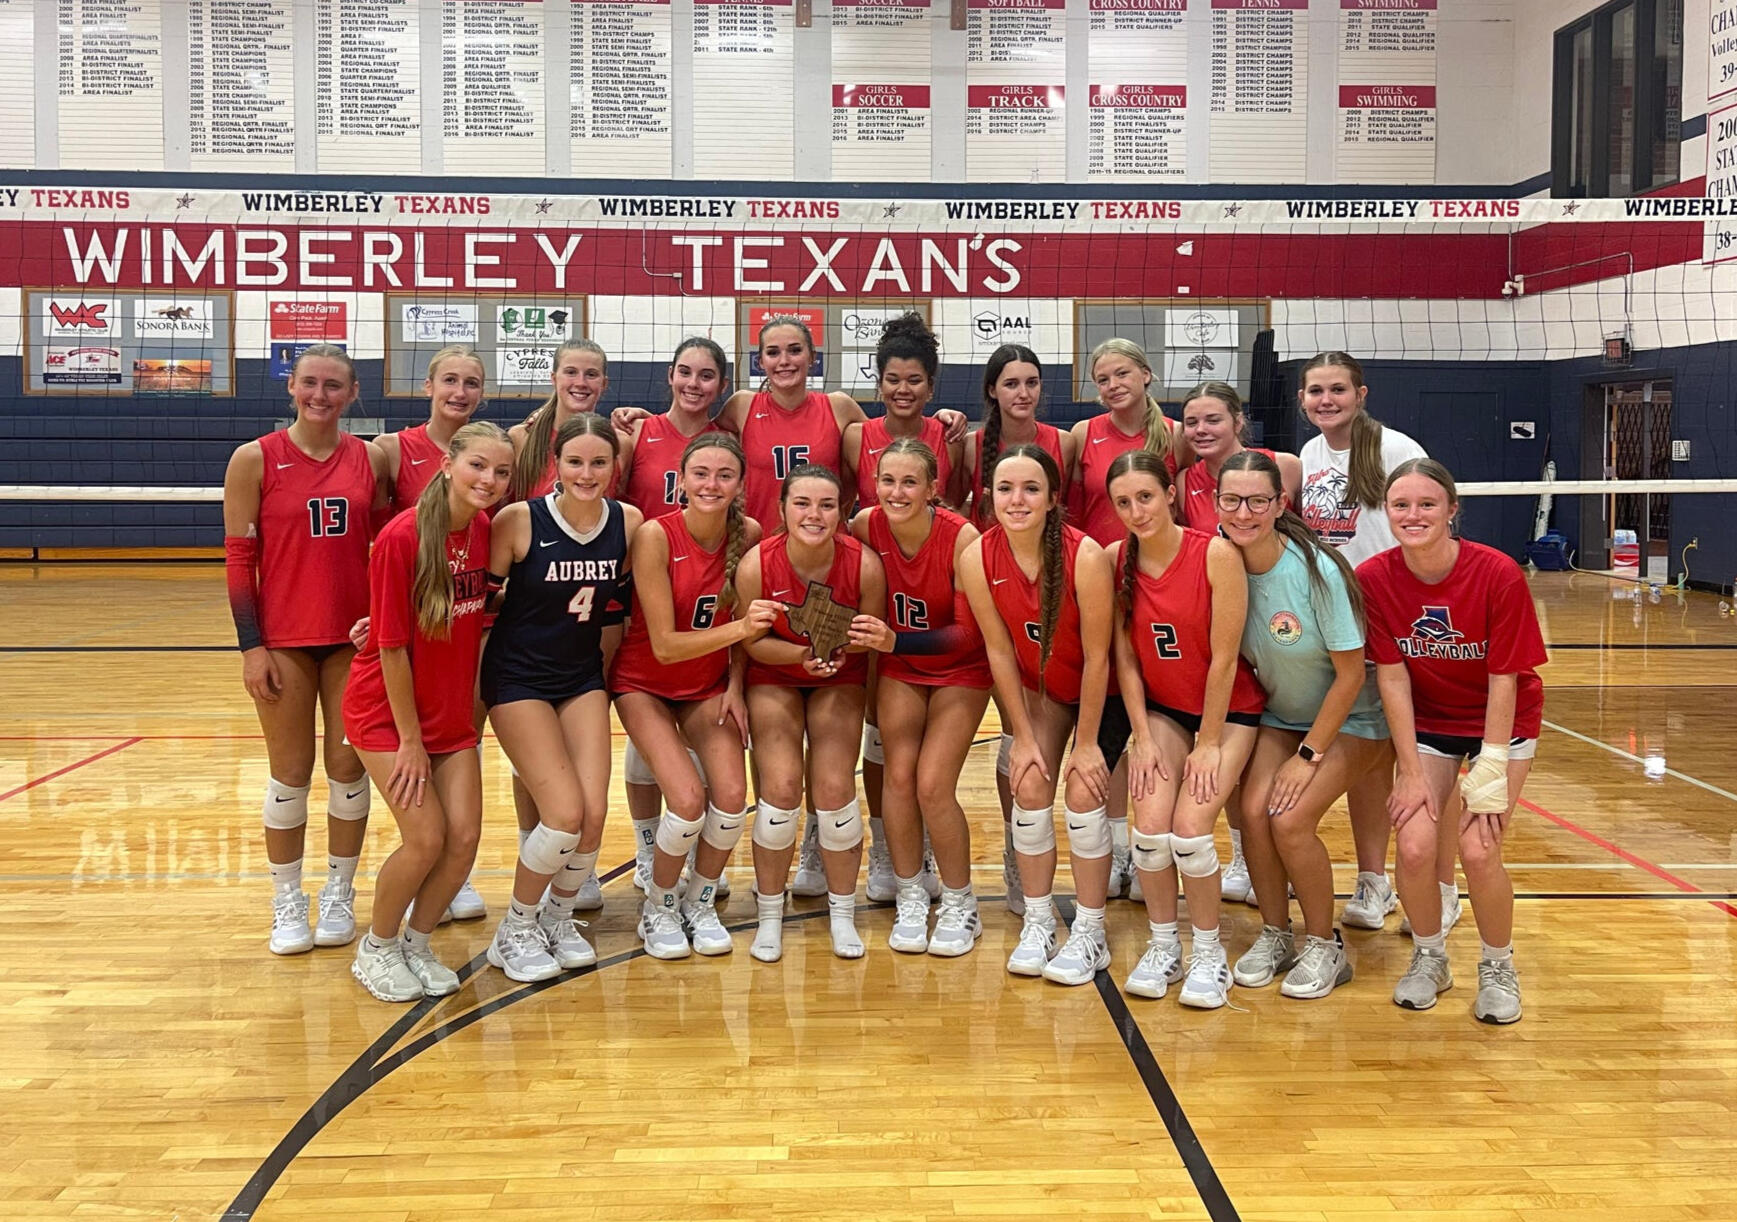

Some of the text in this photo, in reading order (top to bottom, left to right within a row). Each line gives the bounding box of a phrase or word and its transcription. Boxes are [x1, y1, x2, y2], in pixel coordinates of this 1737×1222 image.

[1093, 0, 1183, 8] CROSS COUNTRY
[859, 95, 903, 106] SOCCER
[988, 96, 1044, 107] TRACK
[1092, 95, 1183, 106] CROSS COUNTRY
[1357, 96, 1417, 106] SWIMMING
[31, 190, 129, 208] TEXANS
[243, 193, 490, 214] WIMBERLEY TEXANS
[599, 198, 838, 218] WIMBERLEY TEXANS
[946, 202, 1182, 219] WIMBERLEY TEXANS
[1286, 200, 1519, 218] WIMBERLEY TEXANS
[63, 227, 583, 289] WIMBERLEY
[1003, 317, 1032, 328] AAL
[519, 358, 550, 370] Falls
[307, 497, 348, 537] 13
[544, 559, 618, 582] AUBREY
[569, 586, 595, 622] 4
[691, 594, 718, 630] 6
[894, 592, 928, 630] 12
[1151, 623, 1181, 660] 2
